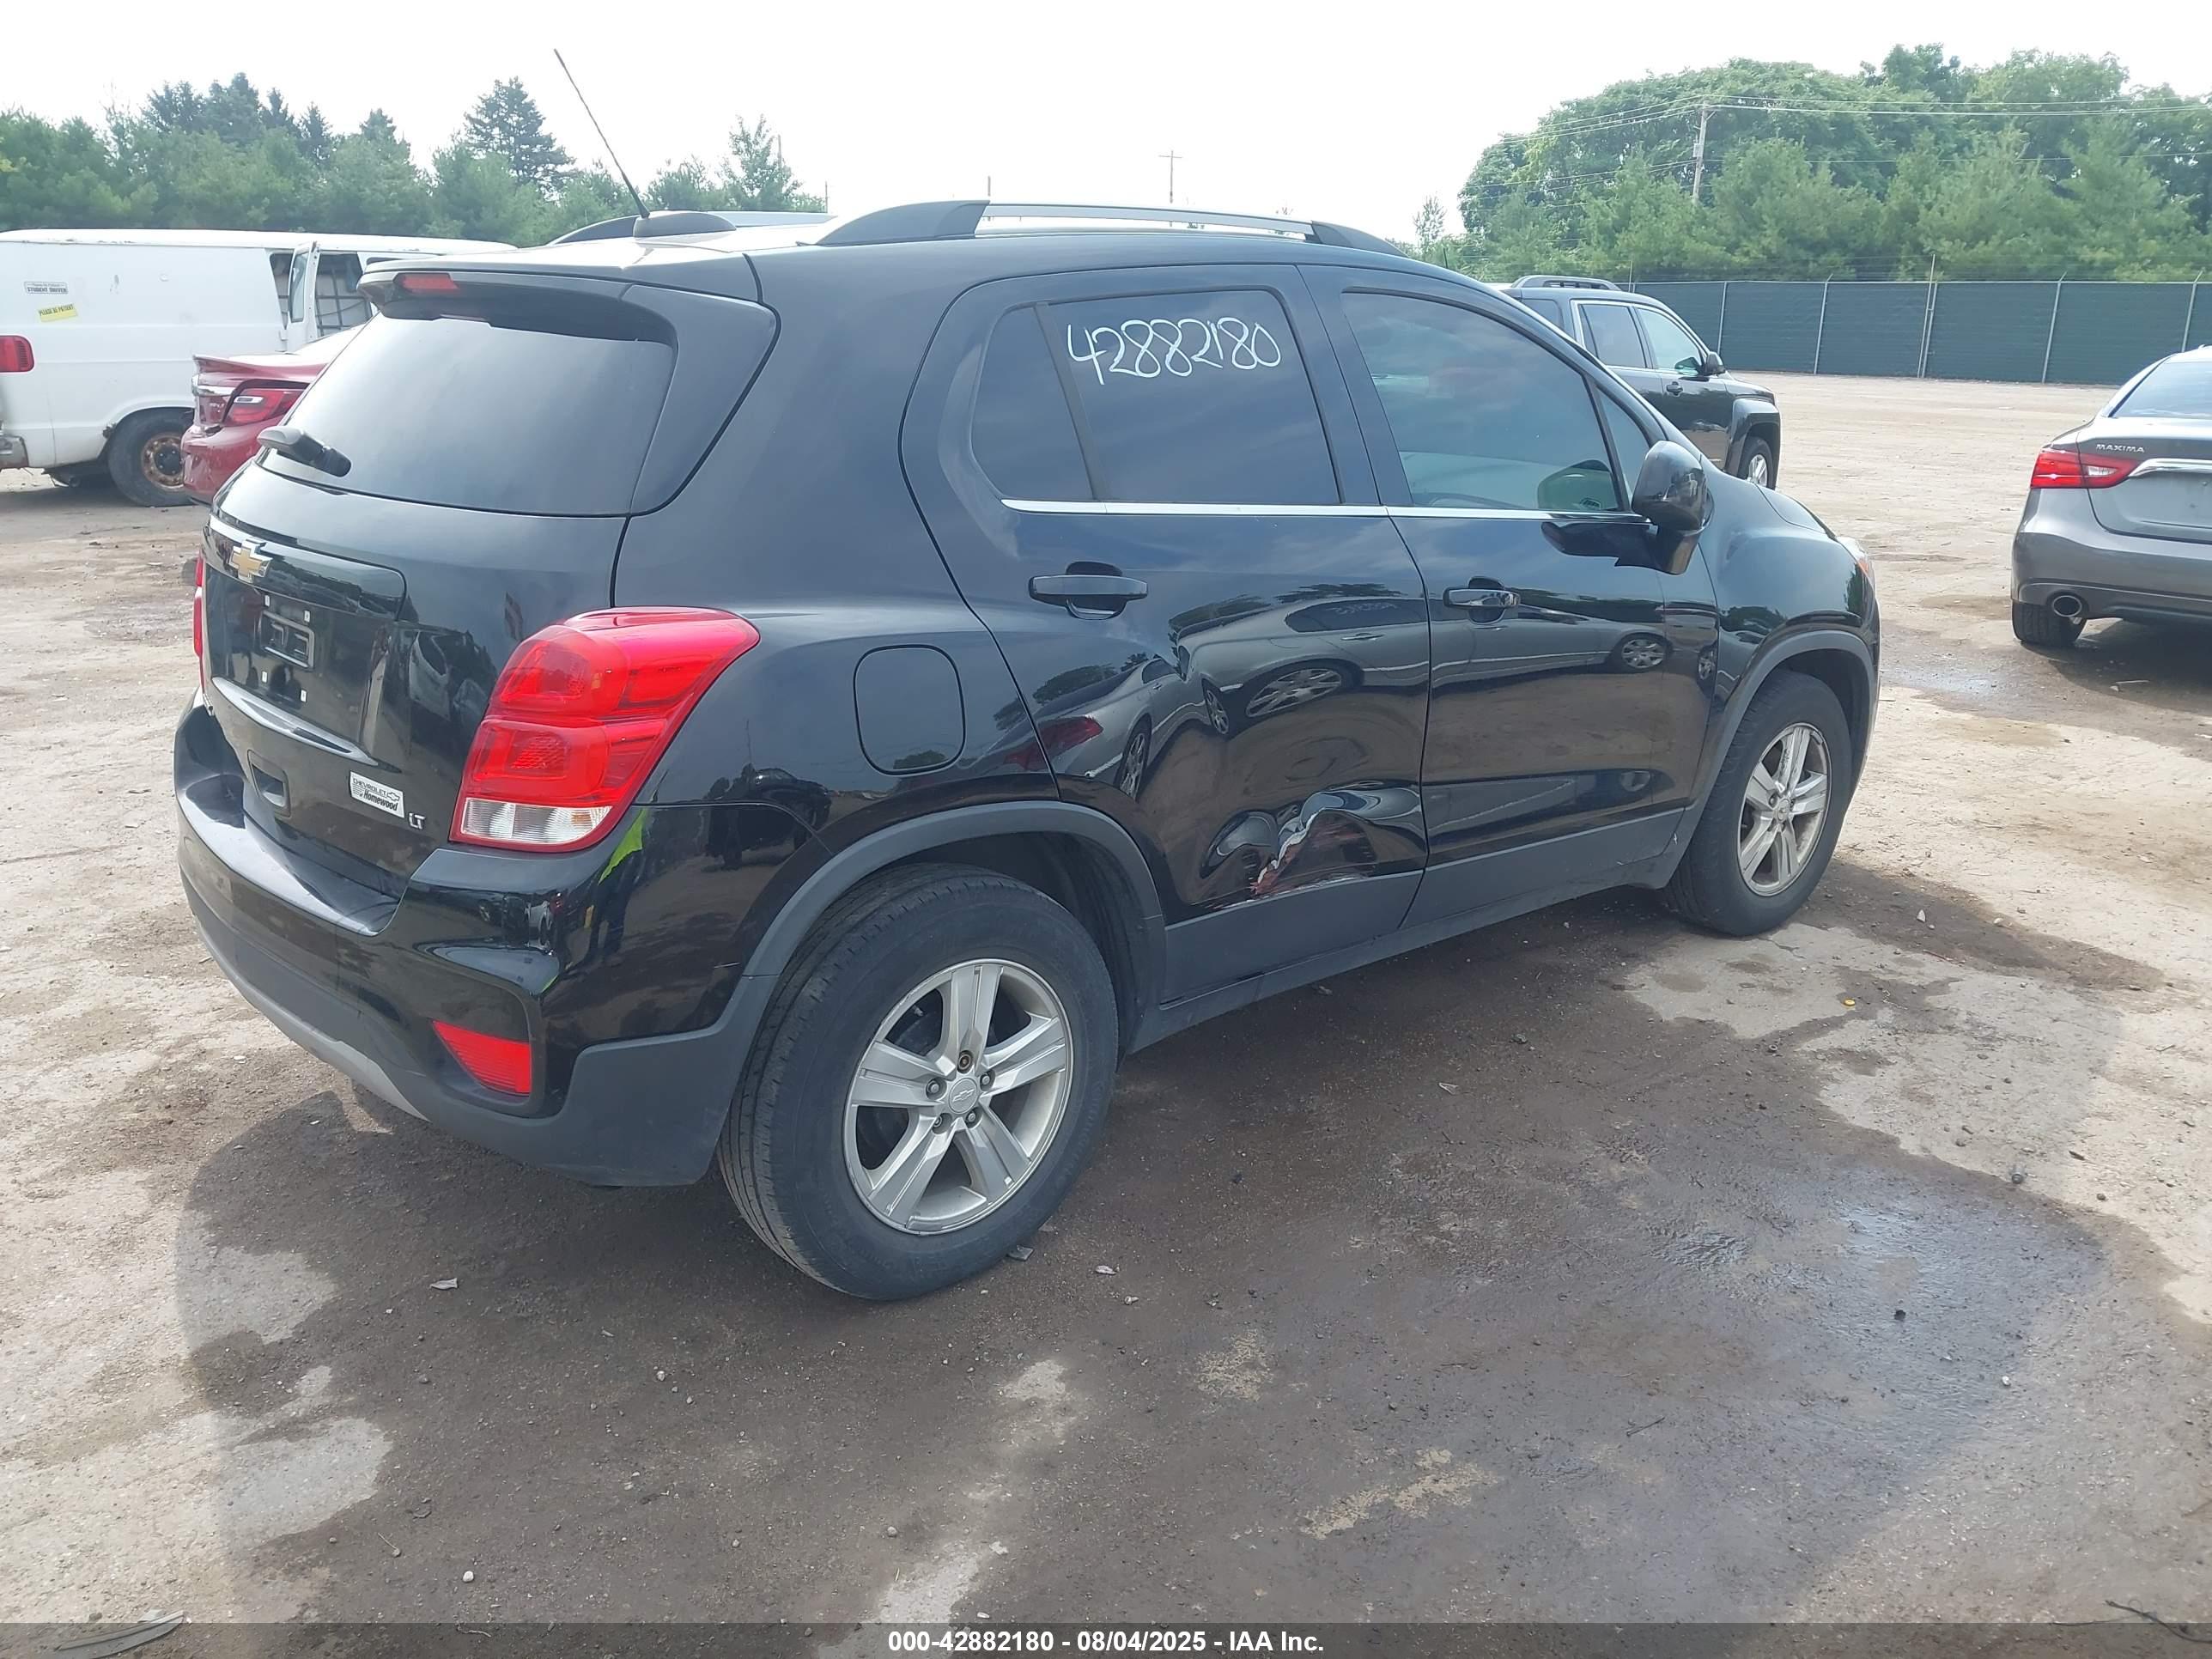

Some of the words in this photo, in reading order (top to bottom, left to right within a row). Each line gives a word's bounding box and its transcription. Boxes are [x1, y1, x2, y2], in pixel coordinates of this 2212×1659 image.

[1067, 316, 1281, 385] 42882180
[2096, 444, 2145, 453] MAXIMA
[353, 778, 386, 797] CHEVROLET
[363, 789, 398, 811] Homewood
[409, 812, 426, 830] LT
